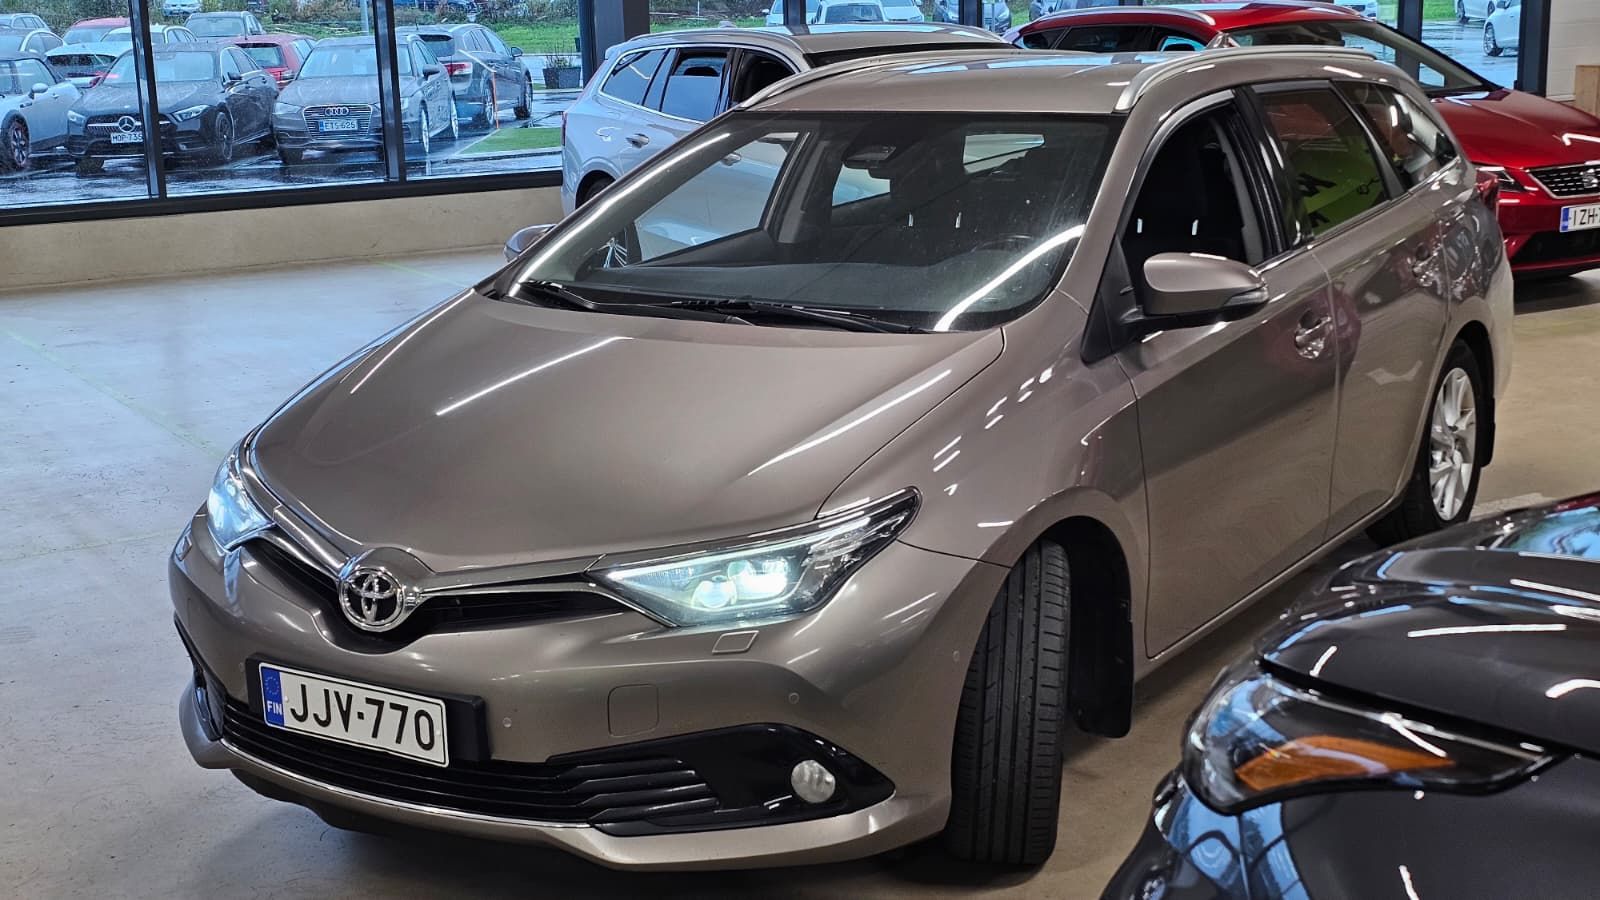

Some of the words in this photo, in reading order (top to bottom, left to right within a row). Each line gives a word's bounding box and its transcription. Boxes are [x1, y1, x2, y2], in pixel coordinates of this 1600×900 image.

[1573, 207, 1600, 226] IZH-
[266, 700, 284, 715] FIN
[290, 684, 435, 750] JJV-770
